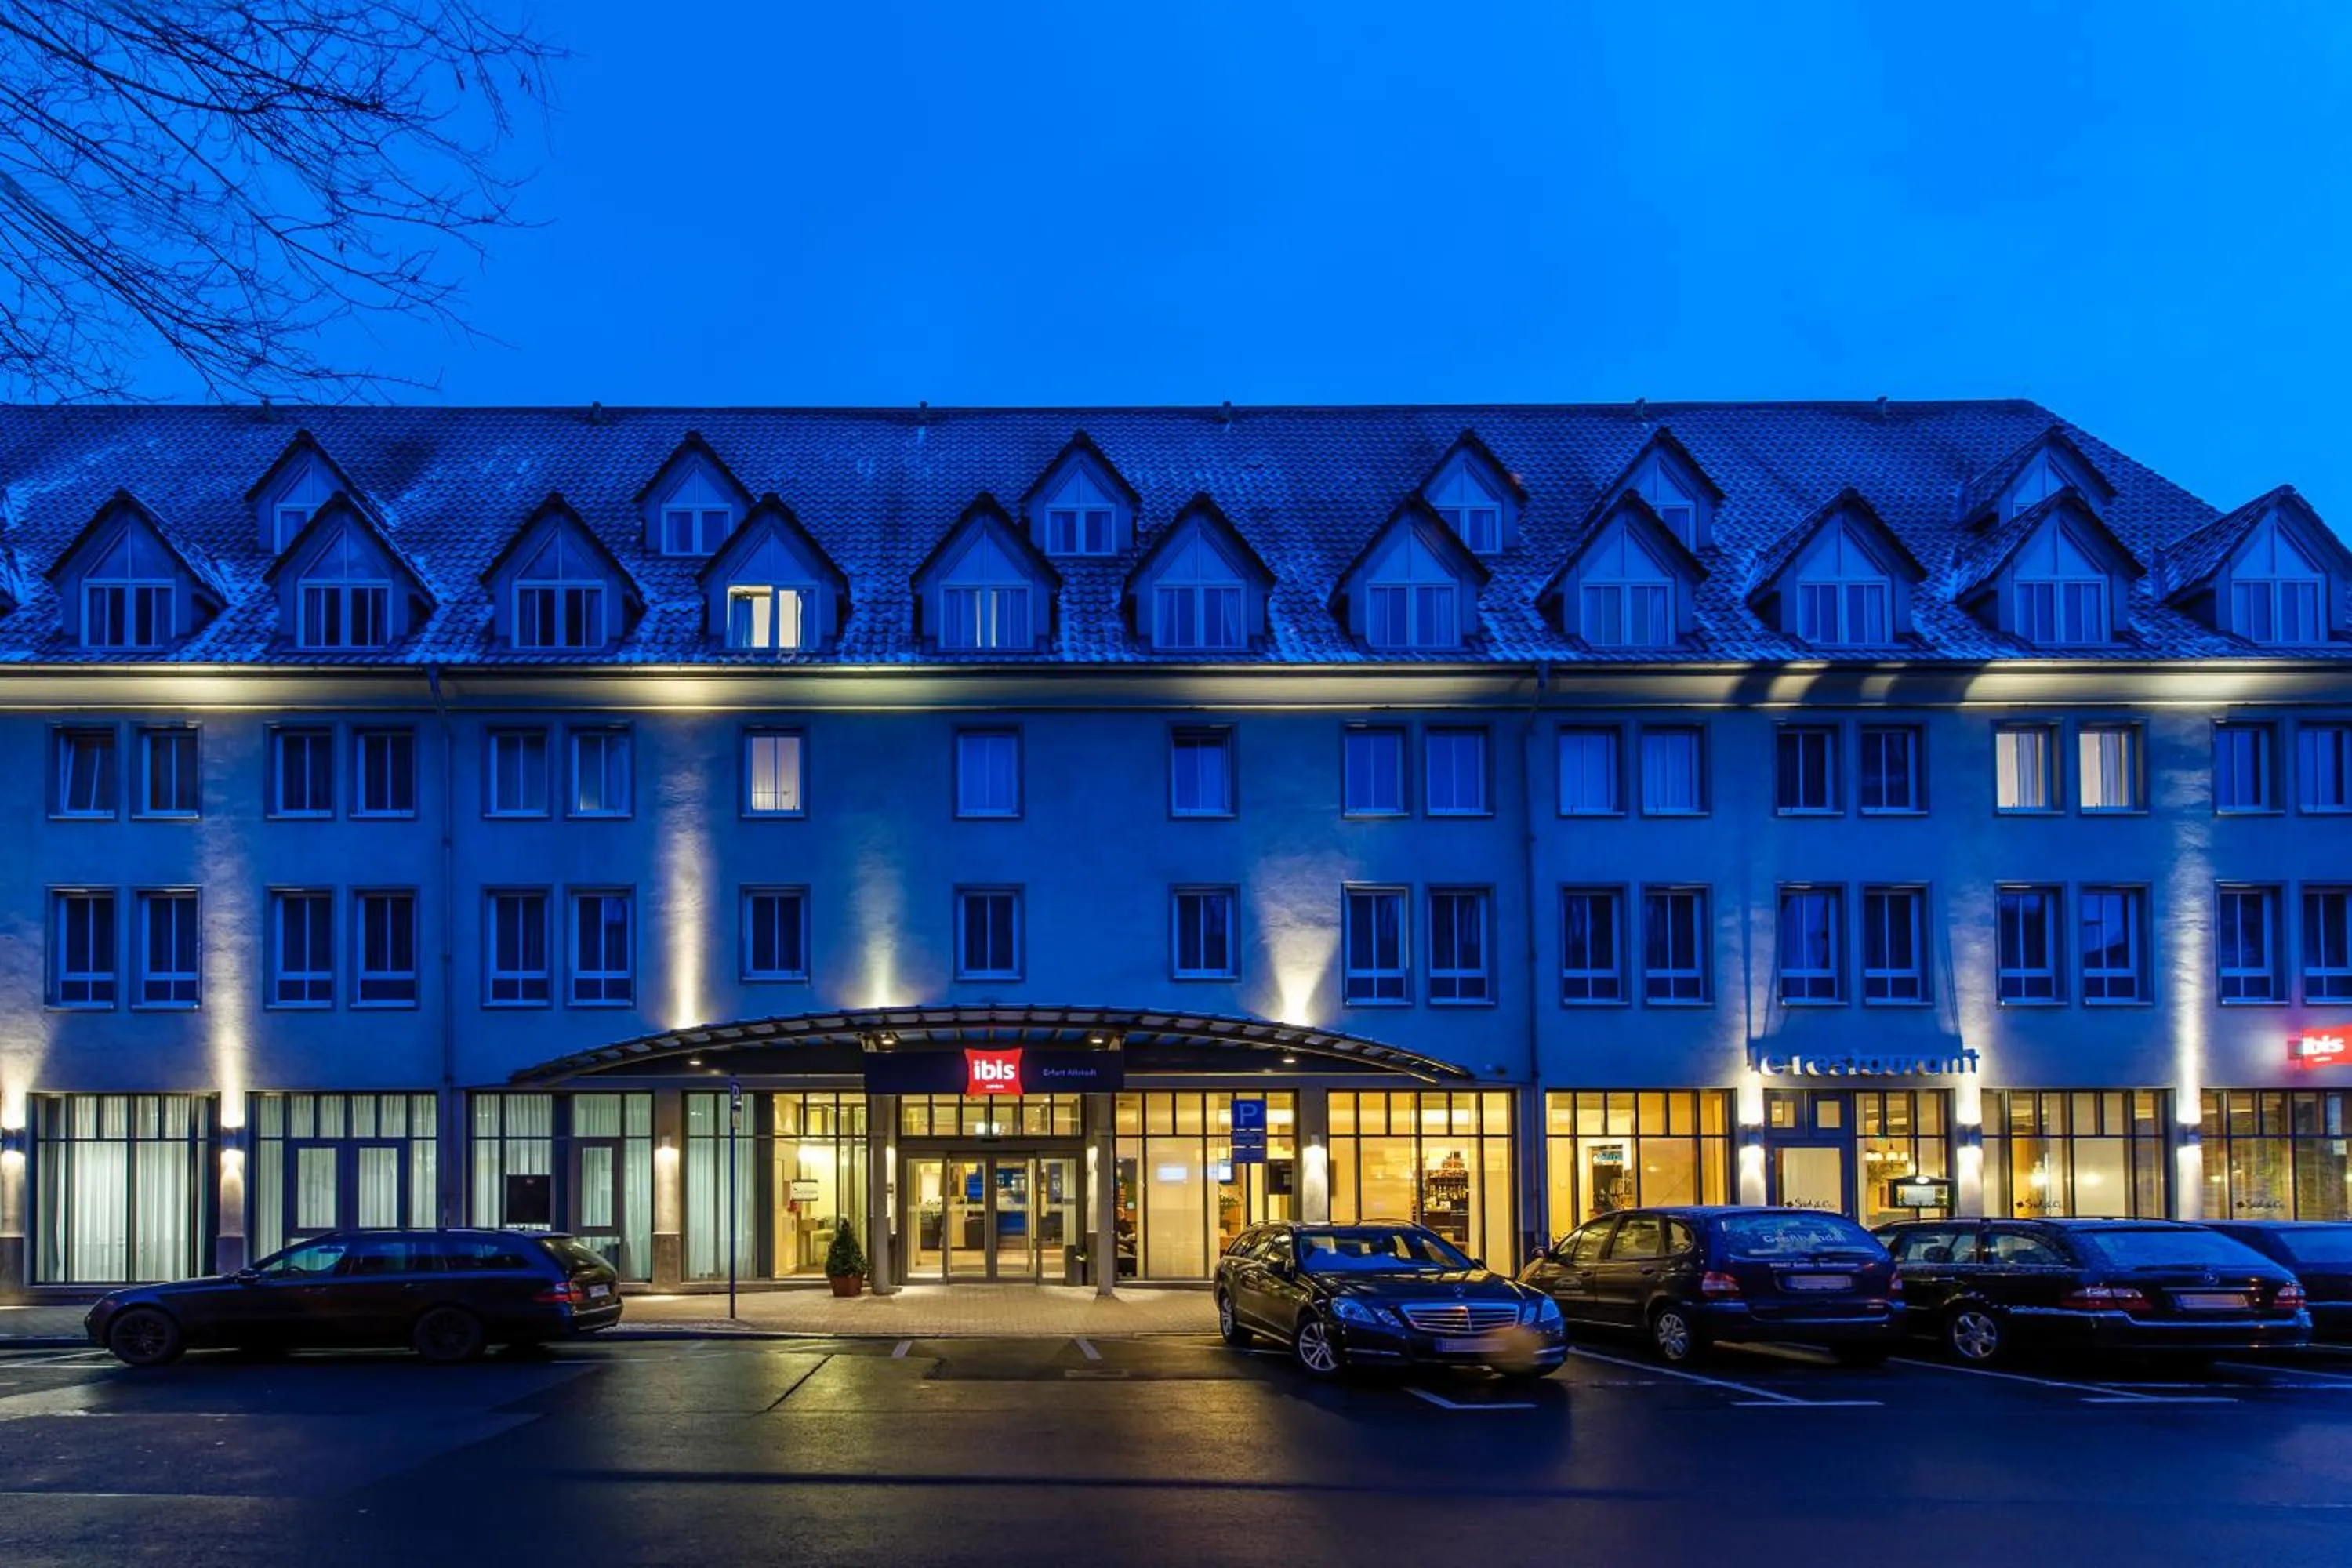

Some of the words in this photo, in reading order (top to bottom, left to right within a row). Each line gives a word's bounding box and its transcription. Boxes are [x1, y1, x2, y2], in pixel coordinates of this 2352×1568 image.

[2302, 1035, 2345, 1055] ibis
[974, 1060, 1015, 1080] ibis
[1798, 1048, 1980, 1075] restaurant
[1239, 1103, 1258, 1126] P
